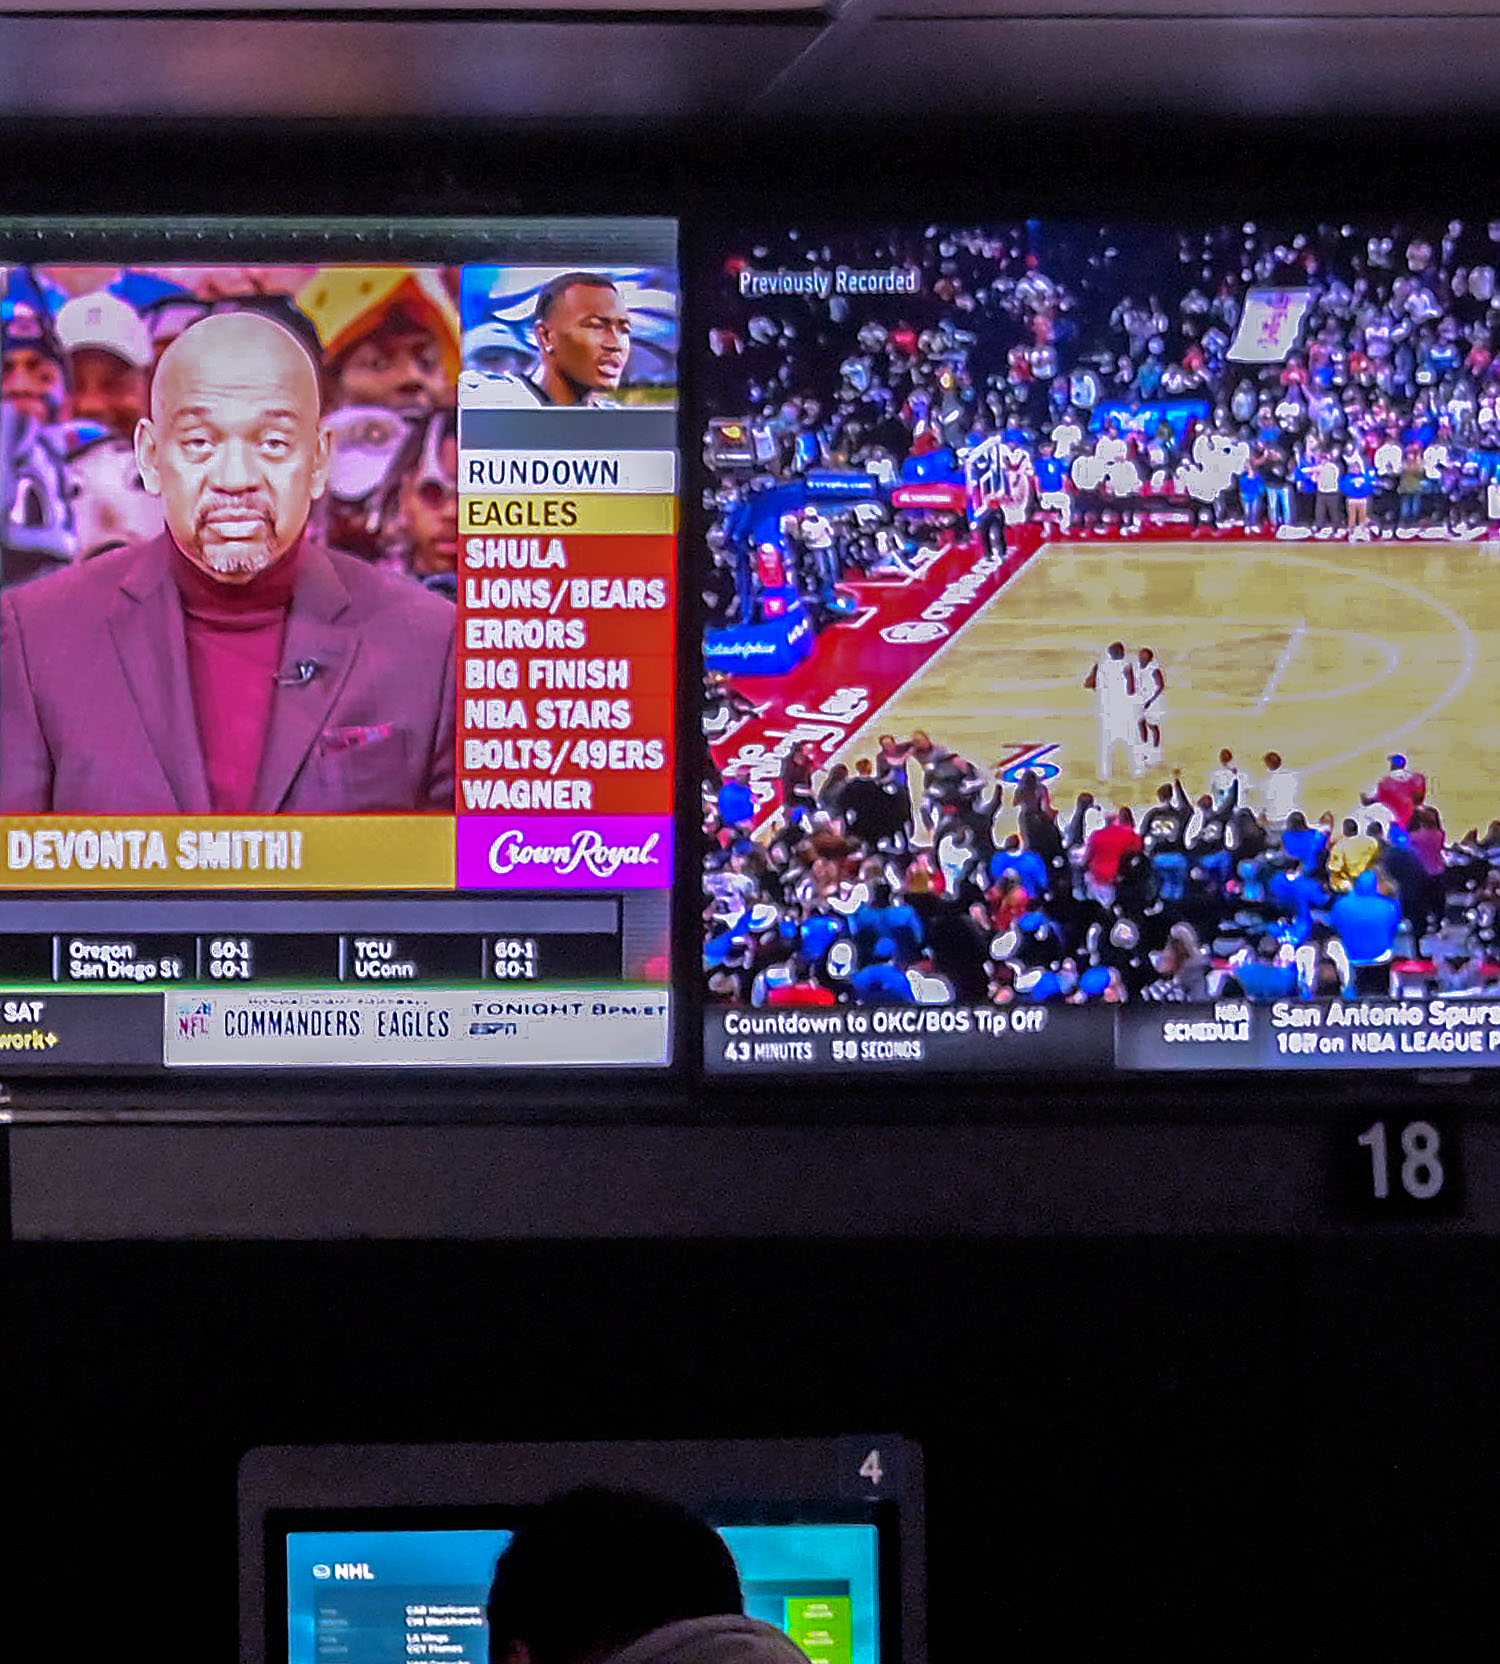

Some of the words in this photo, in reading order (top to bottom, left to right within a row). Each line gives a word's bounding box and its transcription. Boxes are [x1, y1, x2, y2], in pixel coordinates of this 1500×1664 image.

[740, 271, 828, 297] Previously
[835, 270, 915, 294] Recorded
[468, 459, 619, 486] RUNDOWN
[468, 501, 578, 527] EAGLES
[465, 539, 566, 569] SHULA
[465, 579, 666, 615] LIONS/BEARS
[465, 619, 586, 649] ERRORS
[464, 659, 519, 689] BIG
[528, 659, 629, 689] FINISH
[464, 700, 527, 729] NBA
[536, 700, 632, 729] STARS
[464, 740, 665, 775] BOLTS/49ERS
[463, 779, 592, 809] WAGNER
[8, 830, 167, 871] DEVONTA
[175, 830, 304, 871] SMITH!
[488, 829, 571, 875] Crown
[554, 830, 659, 878] Royal
[2, 1002, 44, 1024] SAT
[224, 1009, 361, 1038] COMMANDERS
[378, 1009, 450, 1038] EAGLES
[725, 1013, 842, 1034] Countdown
[846, 1014, 867, 1032] to
[872, 1011, 970, 1032] OKC/BOS
[973, 1010, 1006, 1035] Tip
[1010, 1009, 1043, 1031] Off
[1271, 1003, 1320, 1028] San
[1326, 1002, 1423, 1027] Antonio
[1357, 1121, 1445, 1199] 18
[858, 1450, 883, 1485] 4
[334, 1564, 374, 1580] NHL
